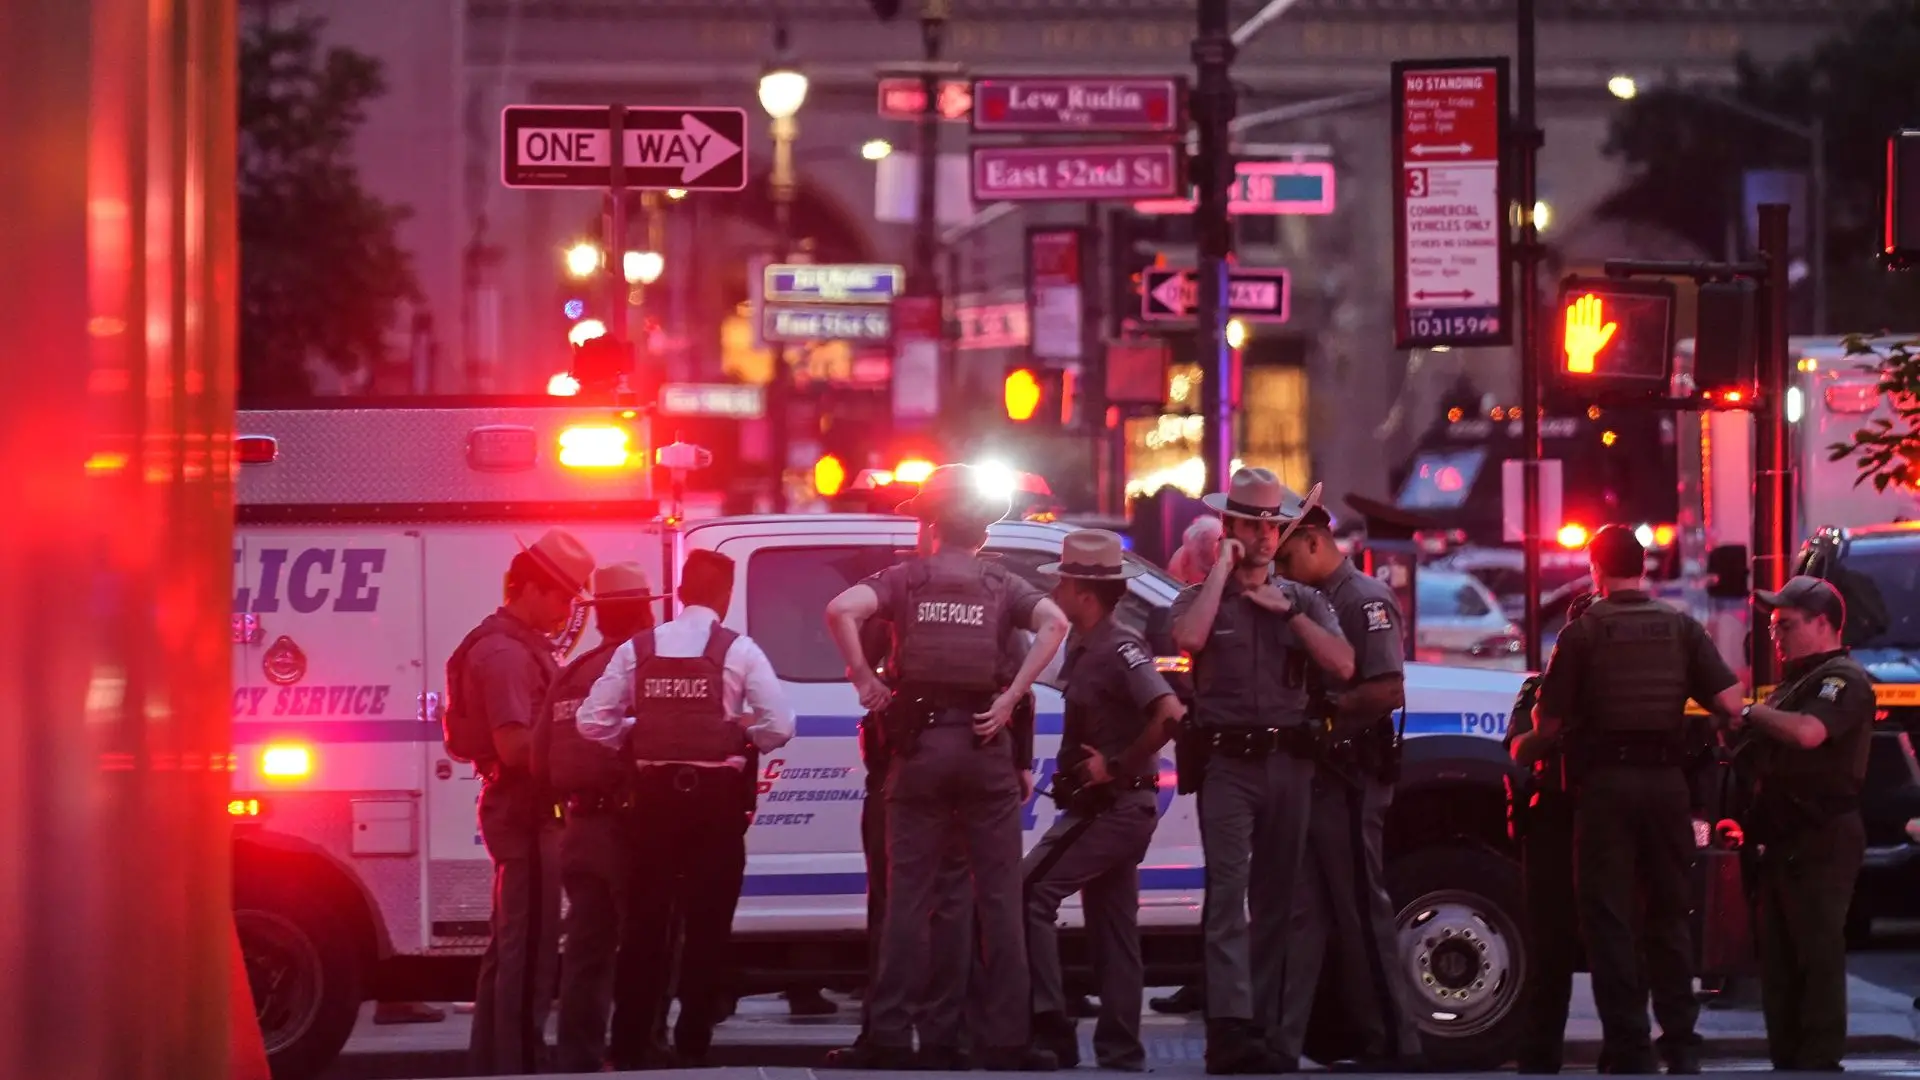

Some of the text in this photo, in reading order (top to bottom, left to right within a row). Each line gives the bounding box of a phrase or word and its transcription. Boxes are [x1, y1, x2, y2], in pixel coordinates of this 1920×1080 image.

[1407, 76, 1483, 91] NO STANDING
[1009, 83, 1141, 110] Lew Rudin
[1057, 109, 1091, 125] Way
[526, 131, 712, 164] ONE WAY
[985, 157, 1163, 189] East 52nd St
[1409, 171, 1425, 197] 3
[1409, 204, 1479, 218] COMMERCIAL
[1410, 220, 1491, 233] VEHICLES ONLY
[917, 601, 984, 625] STATE POLICE
[644, 678, 707, 698] STATE POLICE
[272, 685, 391, 716] SERVICE
[753, 813, 815, 826] ESPECT
